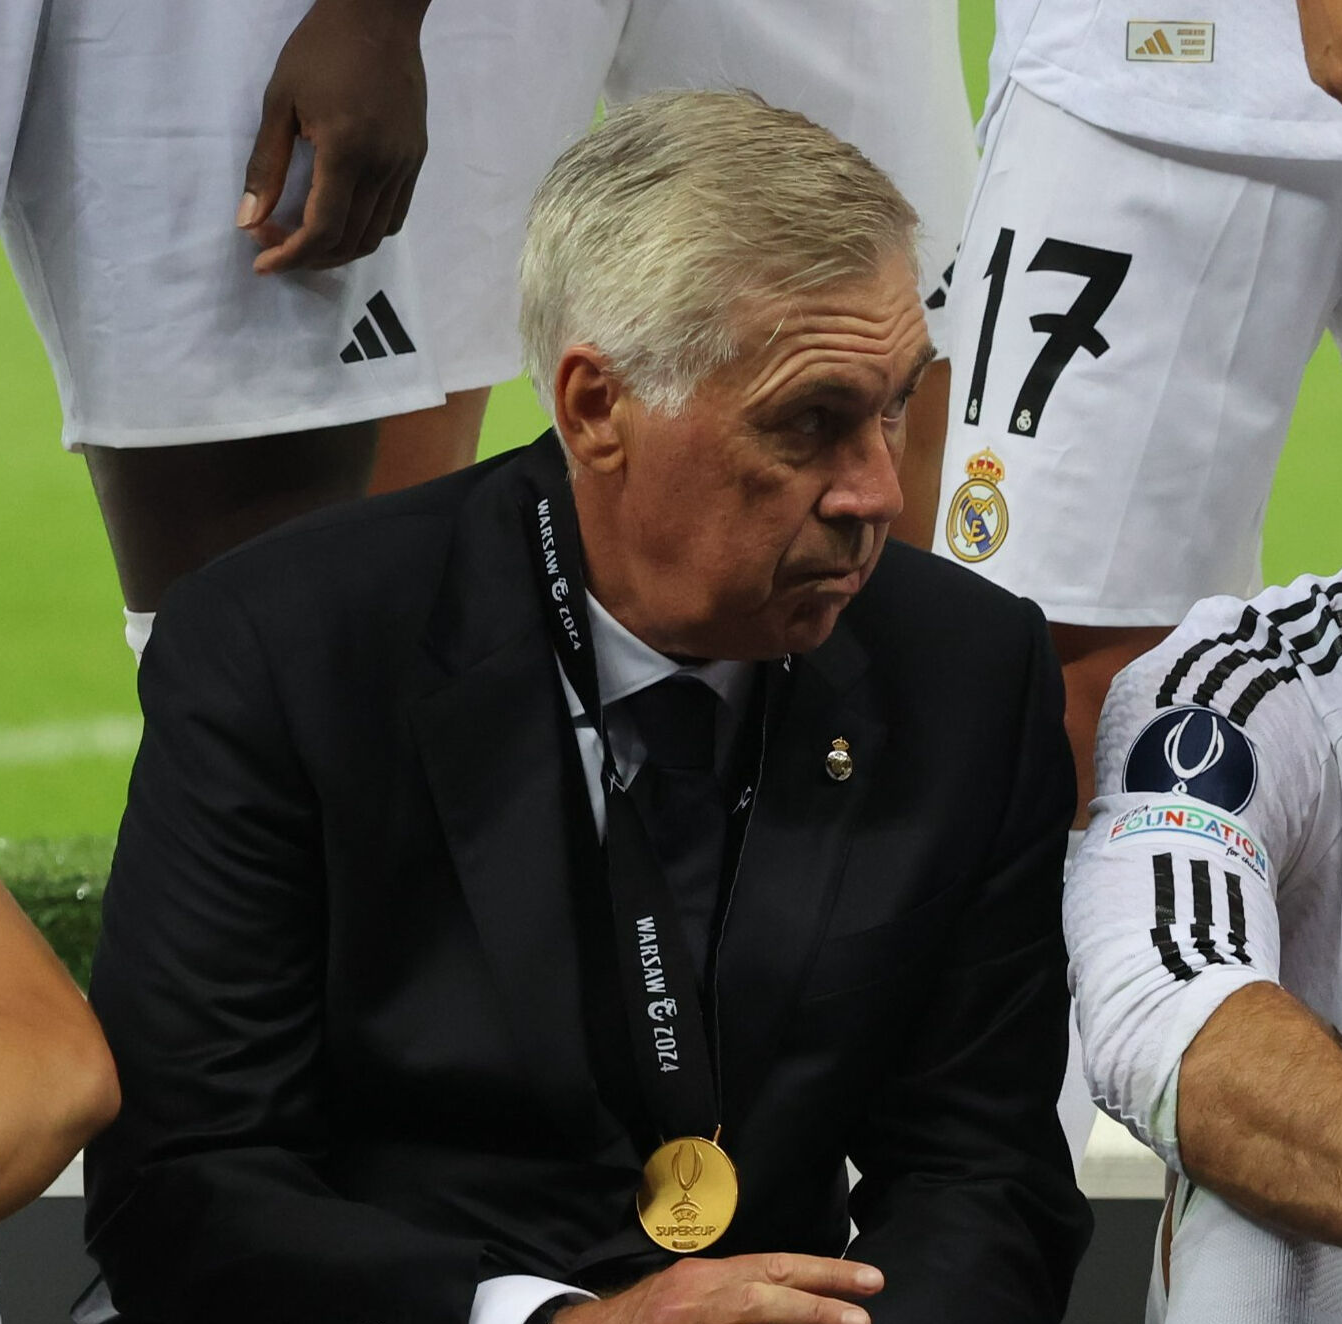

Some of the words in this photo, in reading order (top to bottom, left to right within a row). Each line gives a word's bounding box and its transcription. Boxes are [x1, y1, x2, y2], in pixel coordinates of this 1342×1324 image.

[964, 227, 1133, 438] 17
[537, 498, 560, 575] WARSAW
[559, 605, 582, 650] 2024
[1110, 810, 1267, 873] FOUNDATION
[636, 915, 667, 993] WARSAW
[653, 1025, 680, 1073] 2024
